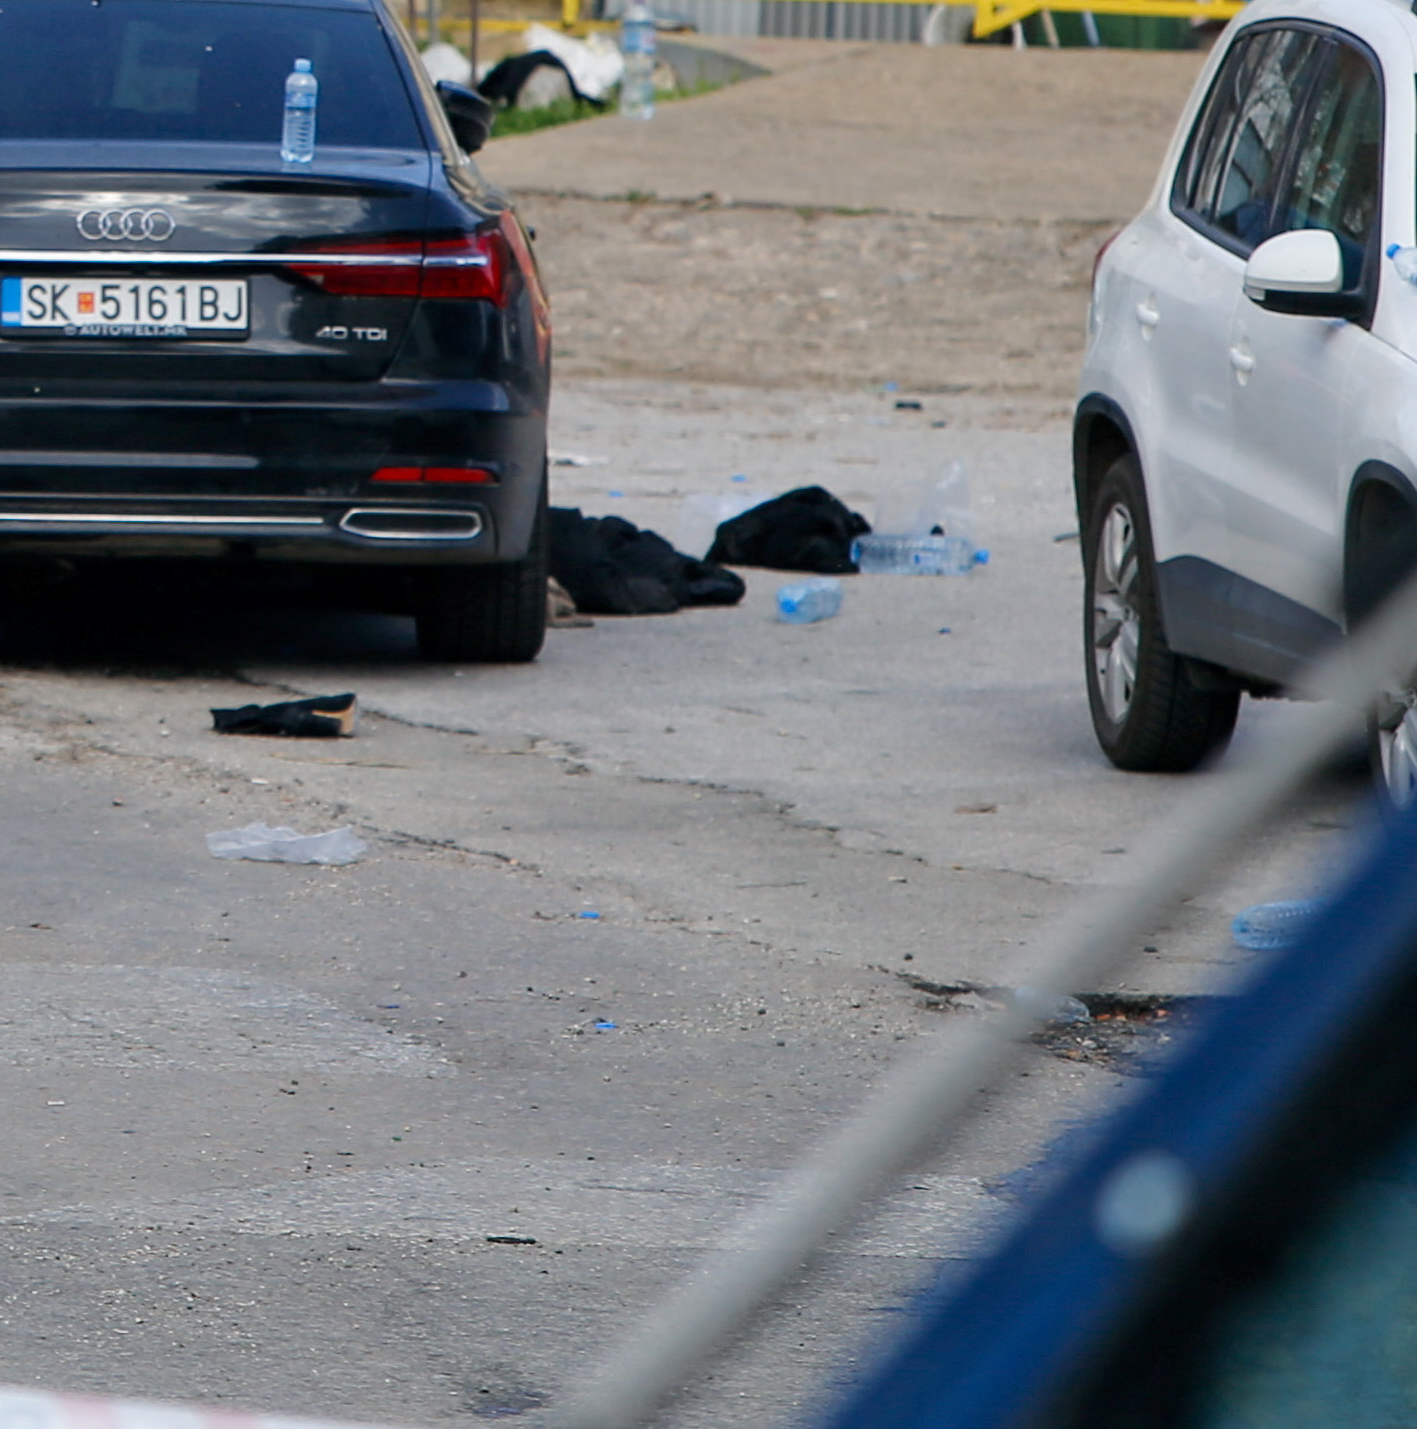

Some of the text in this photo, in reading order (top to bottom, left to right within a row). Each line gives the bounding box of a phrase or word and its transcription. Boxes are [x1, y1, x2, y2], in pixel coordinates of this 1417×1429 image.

[27, 283, 243, 322] SK 5161 BJ
[315, 325, 388, 342] 40 TDI
